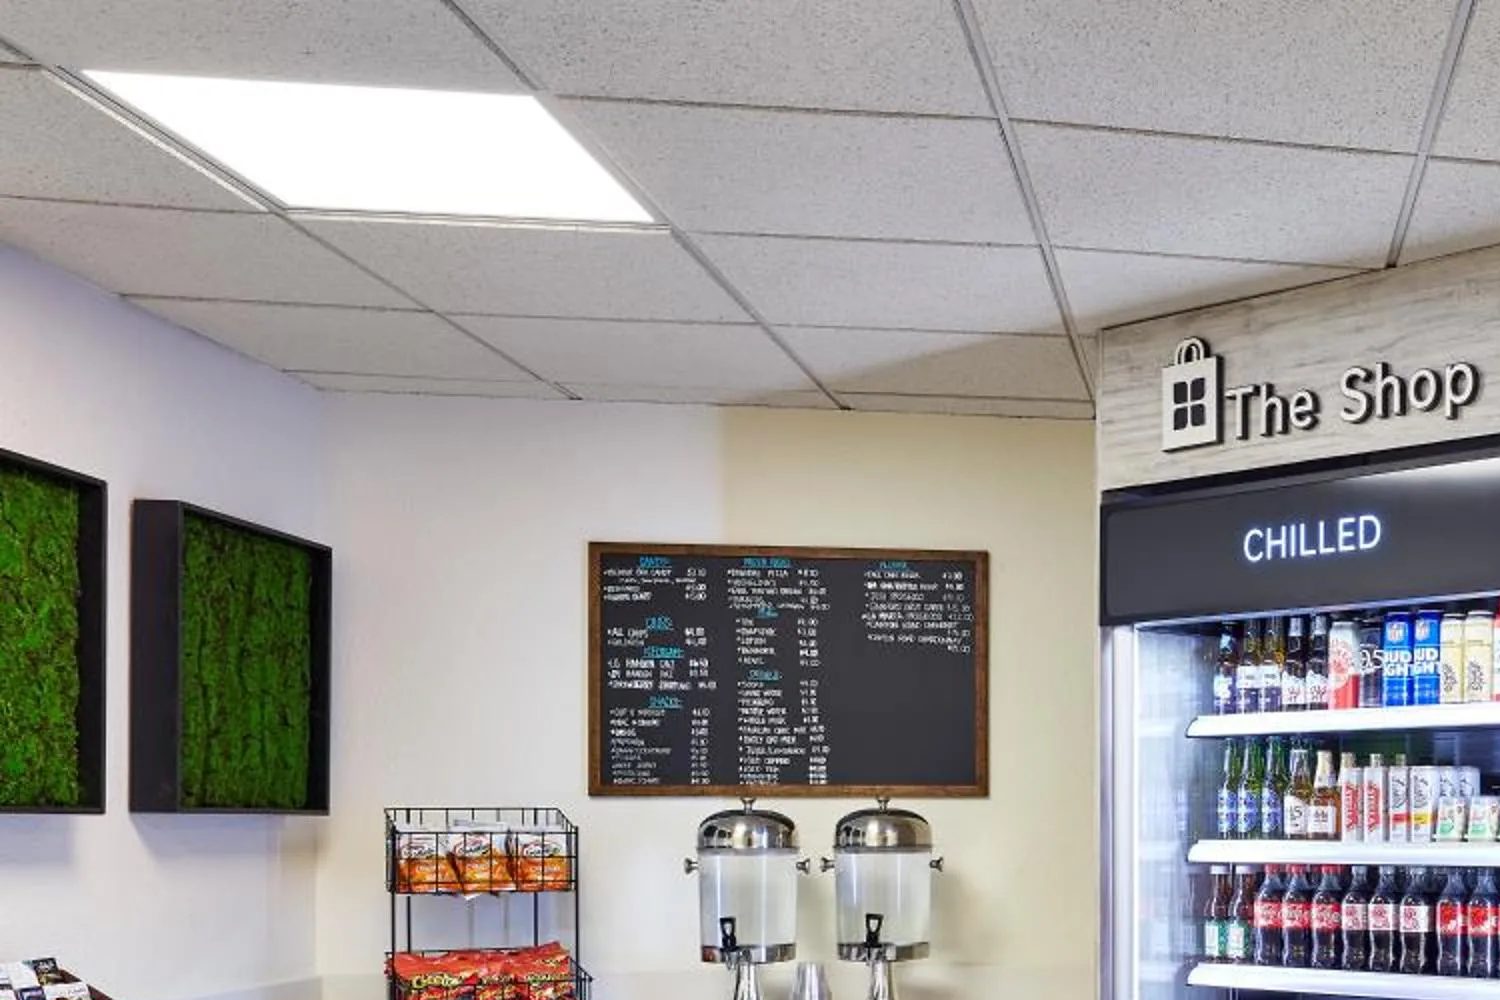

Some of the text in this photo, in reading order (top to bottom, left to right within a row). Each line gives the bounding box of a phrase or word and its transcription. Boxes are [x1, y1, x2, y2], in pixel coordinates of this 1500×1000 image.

[1225, 361, 1482, 440] The Shop
[1243, 514, 1382, 563] CHILLED
